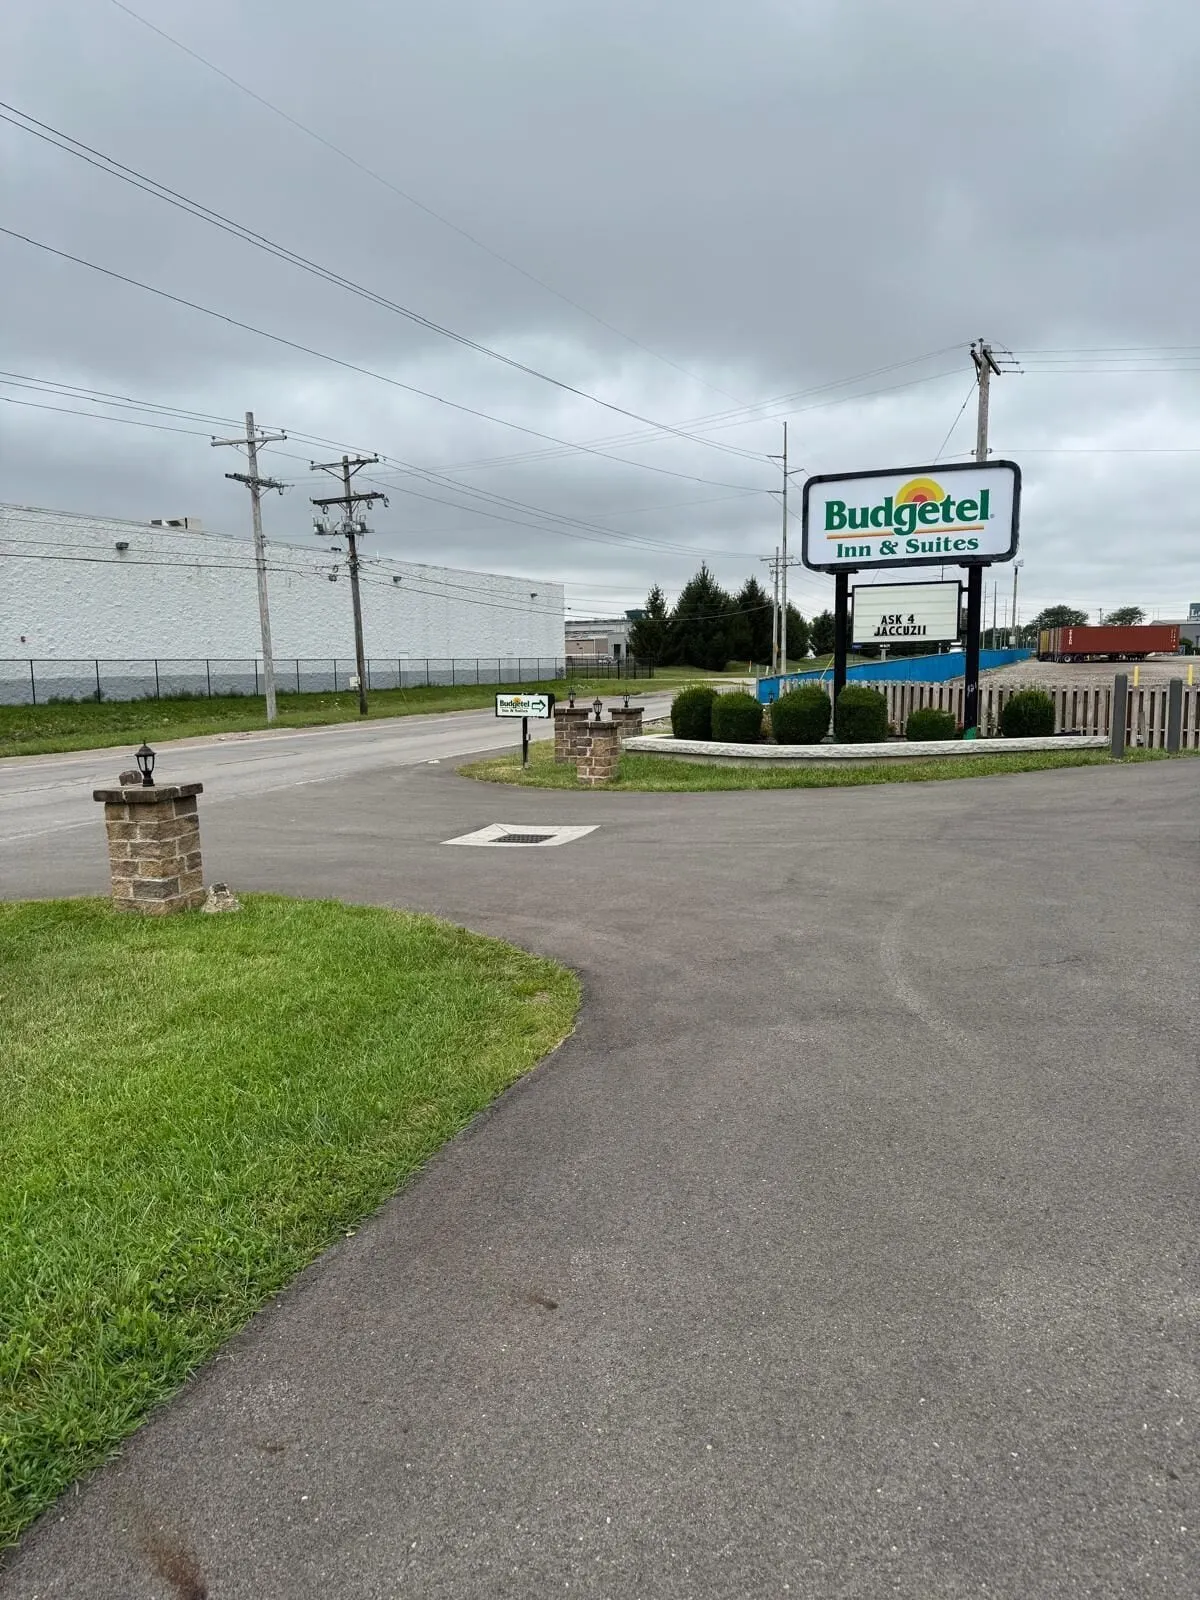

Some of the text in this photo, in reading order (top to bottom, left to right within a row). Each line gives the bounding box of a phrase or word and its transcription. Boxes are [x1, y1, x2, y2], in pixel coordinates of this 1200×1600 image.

[824, 489, 990, 536] Budgetel
[836, 537, 979, 558] Inn & Suites
[881, 614, 915, 625] ASK 4
[500, 699, 529, 708] Budgetel
